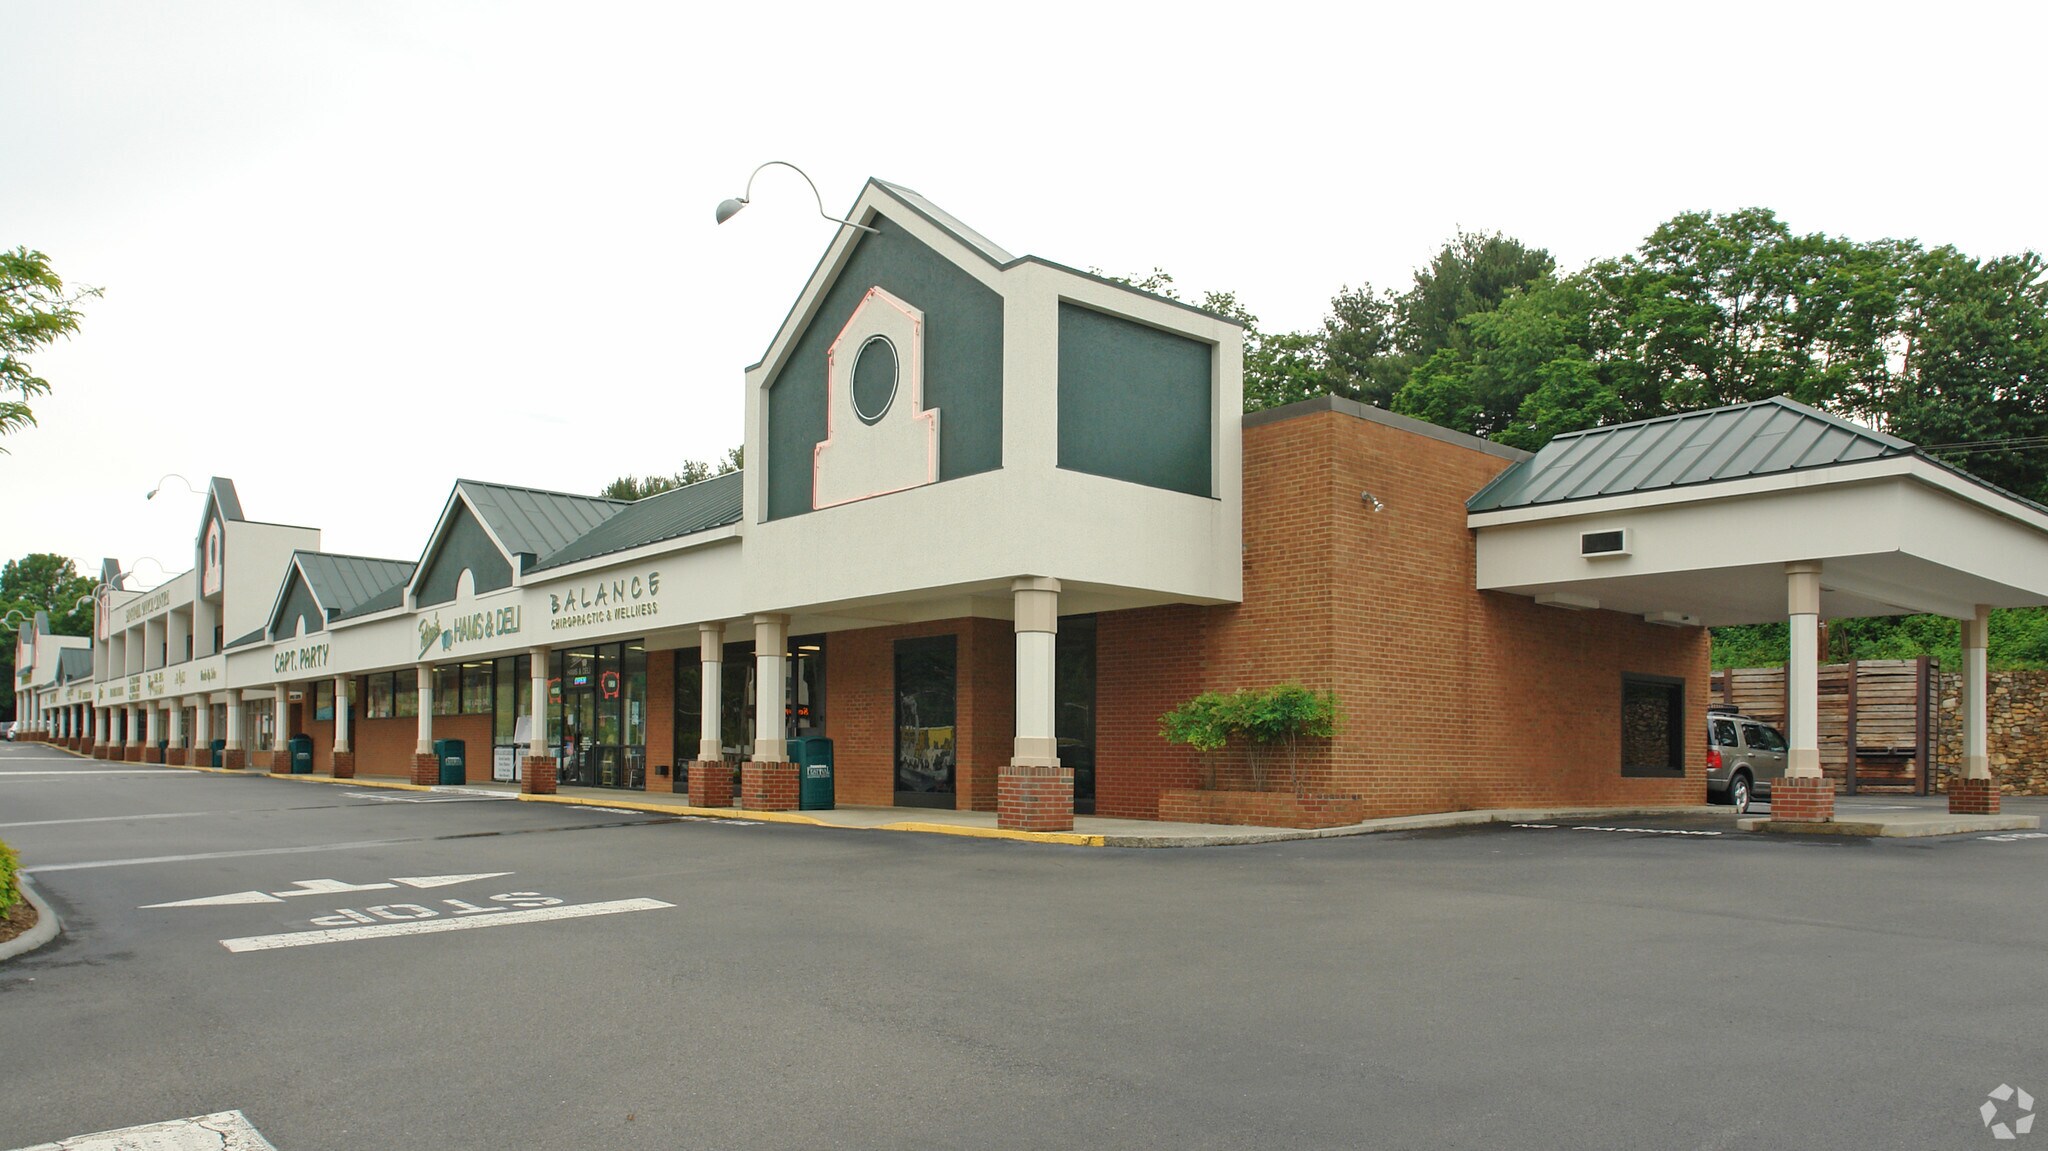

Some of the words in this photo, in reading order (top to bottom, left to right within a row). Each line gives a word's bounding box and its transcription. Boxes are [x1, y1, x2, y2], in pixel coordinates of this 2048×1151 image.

[550, 572, 660, 615] BALANCE
[454, 612, 484, 643] HAMS
[485, 611, 494, 639] &
[496, 605, 521, 636] DELI
[551, 610, 605, 630] CHIROPRACTIC
[606, 610, 612, 621] &
[614, 602, 658, 621] WELLNESS
[275, 650, 298, 674] CAPT.
[300, 643, 329, 670] PARTY
[310, 892, 564, 926] STOP
